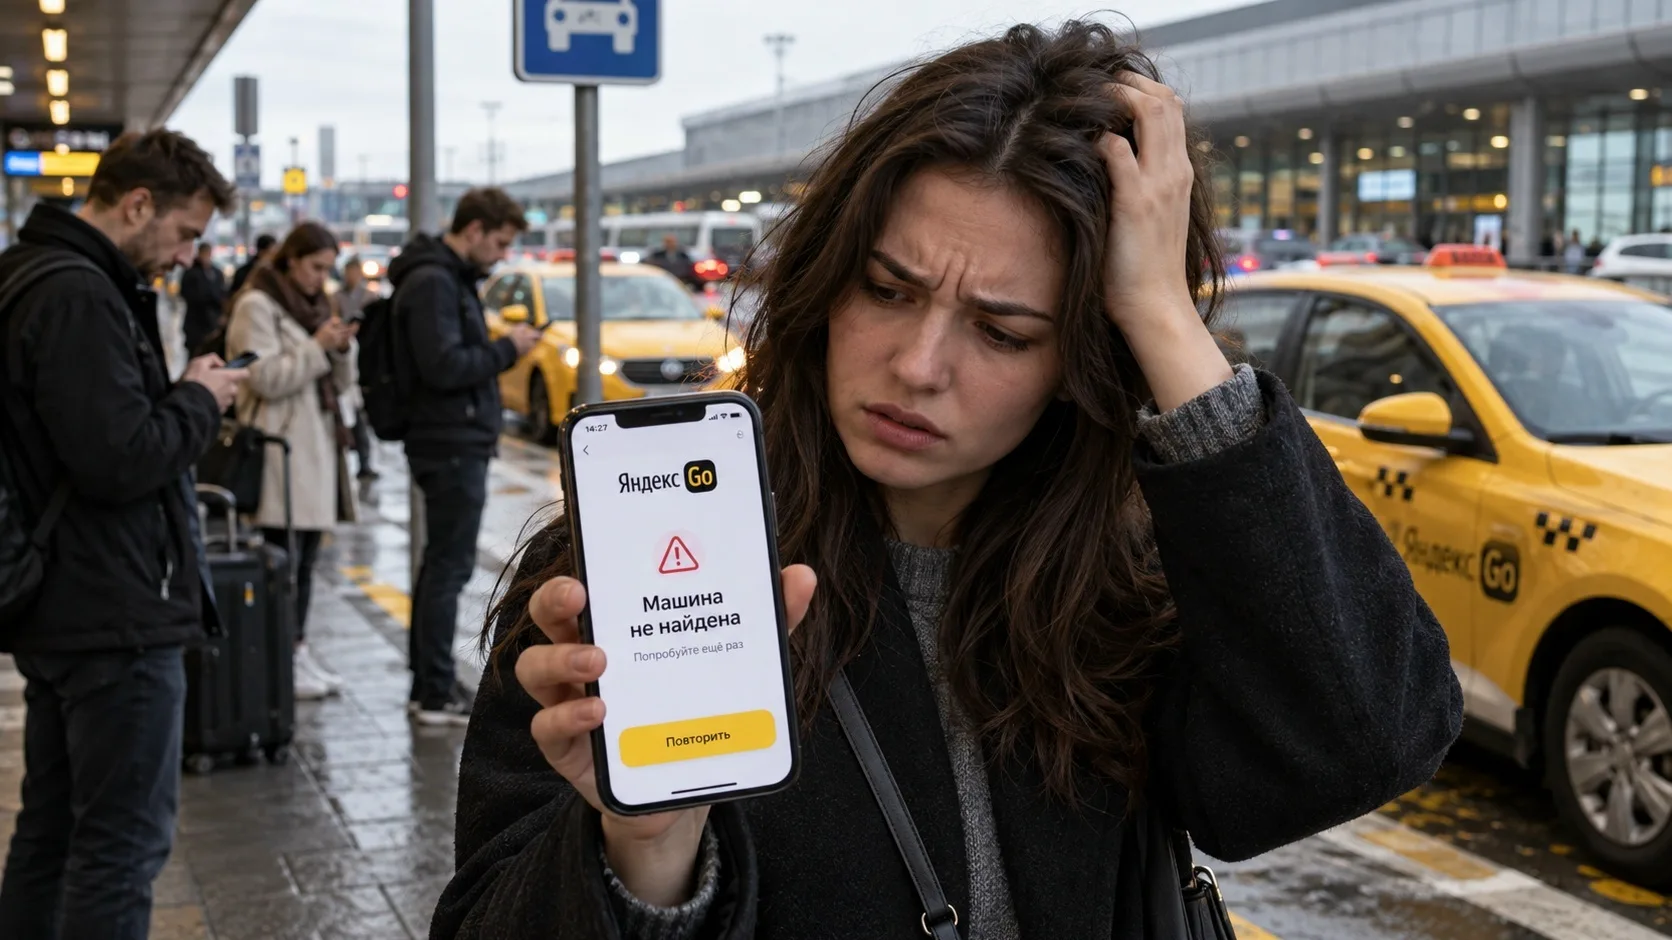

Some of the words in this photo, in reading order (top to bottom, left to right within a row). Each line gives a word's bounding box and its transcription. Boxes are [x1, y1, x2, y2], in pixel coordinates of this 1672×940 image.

[585, 424, 608, 433] 14:27
[618, 472, 681, 494] Яндекс
[687, 465, 713, 487] Go
[1483, 548, 1517, 593] Go
[642, 591, 723, 612] Машина
[630, 622, 654, 638] не
[659, 612, 741, 634] найдена
[633, 646, 700, 662] Попробуйте
[702, 641, 723, 654] ещё
[725, 640, 744, 652] раз
[666, 731, 731, 747] Повторить
